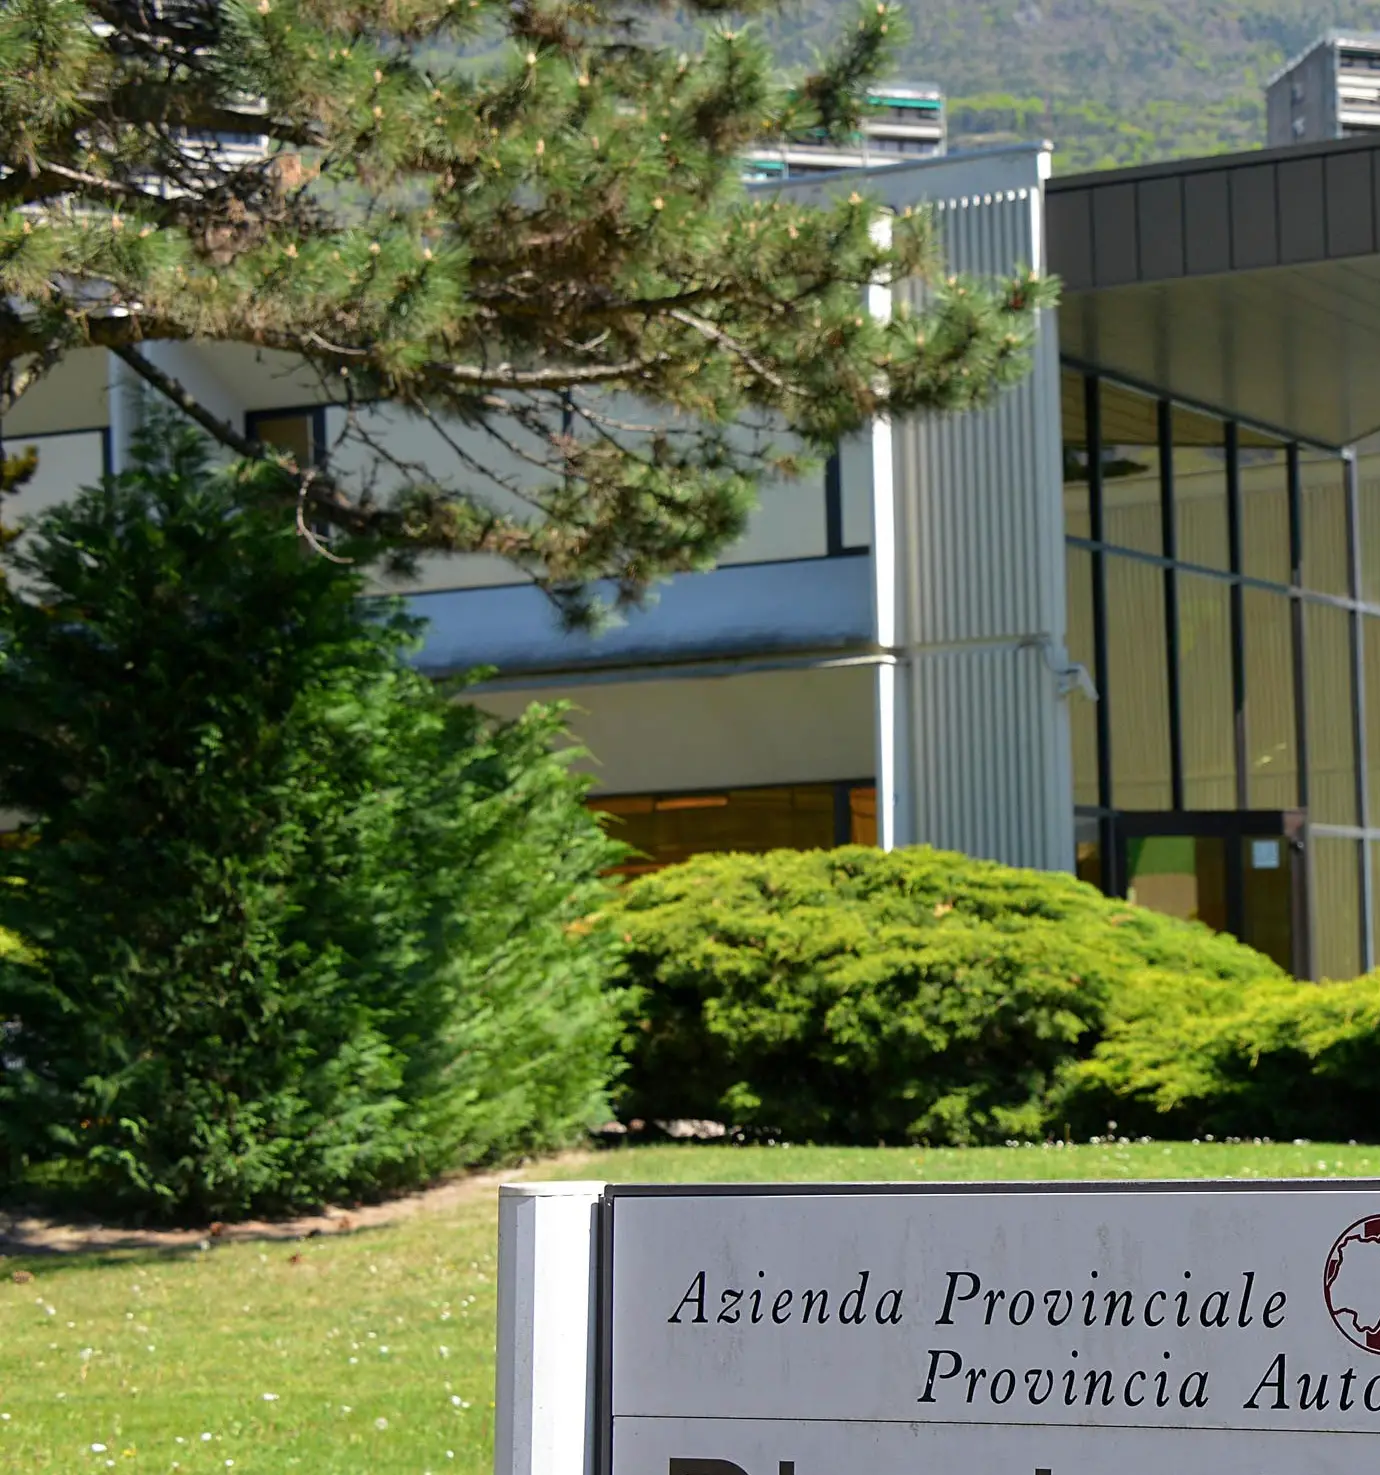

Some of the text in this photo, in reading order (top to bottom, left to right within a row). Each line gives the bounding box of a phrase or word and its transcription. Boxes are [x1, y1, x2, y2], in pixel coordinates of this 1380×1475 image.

[667, 1270, 903, 1325] Azienda
[934, 1270, 1288, 1329] Provinciale
[917, 1349, 1209, 1408] Provincia
